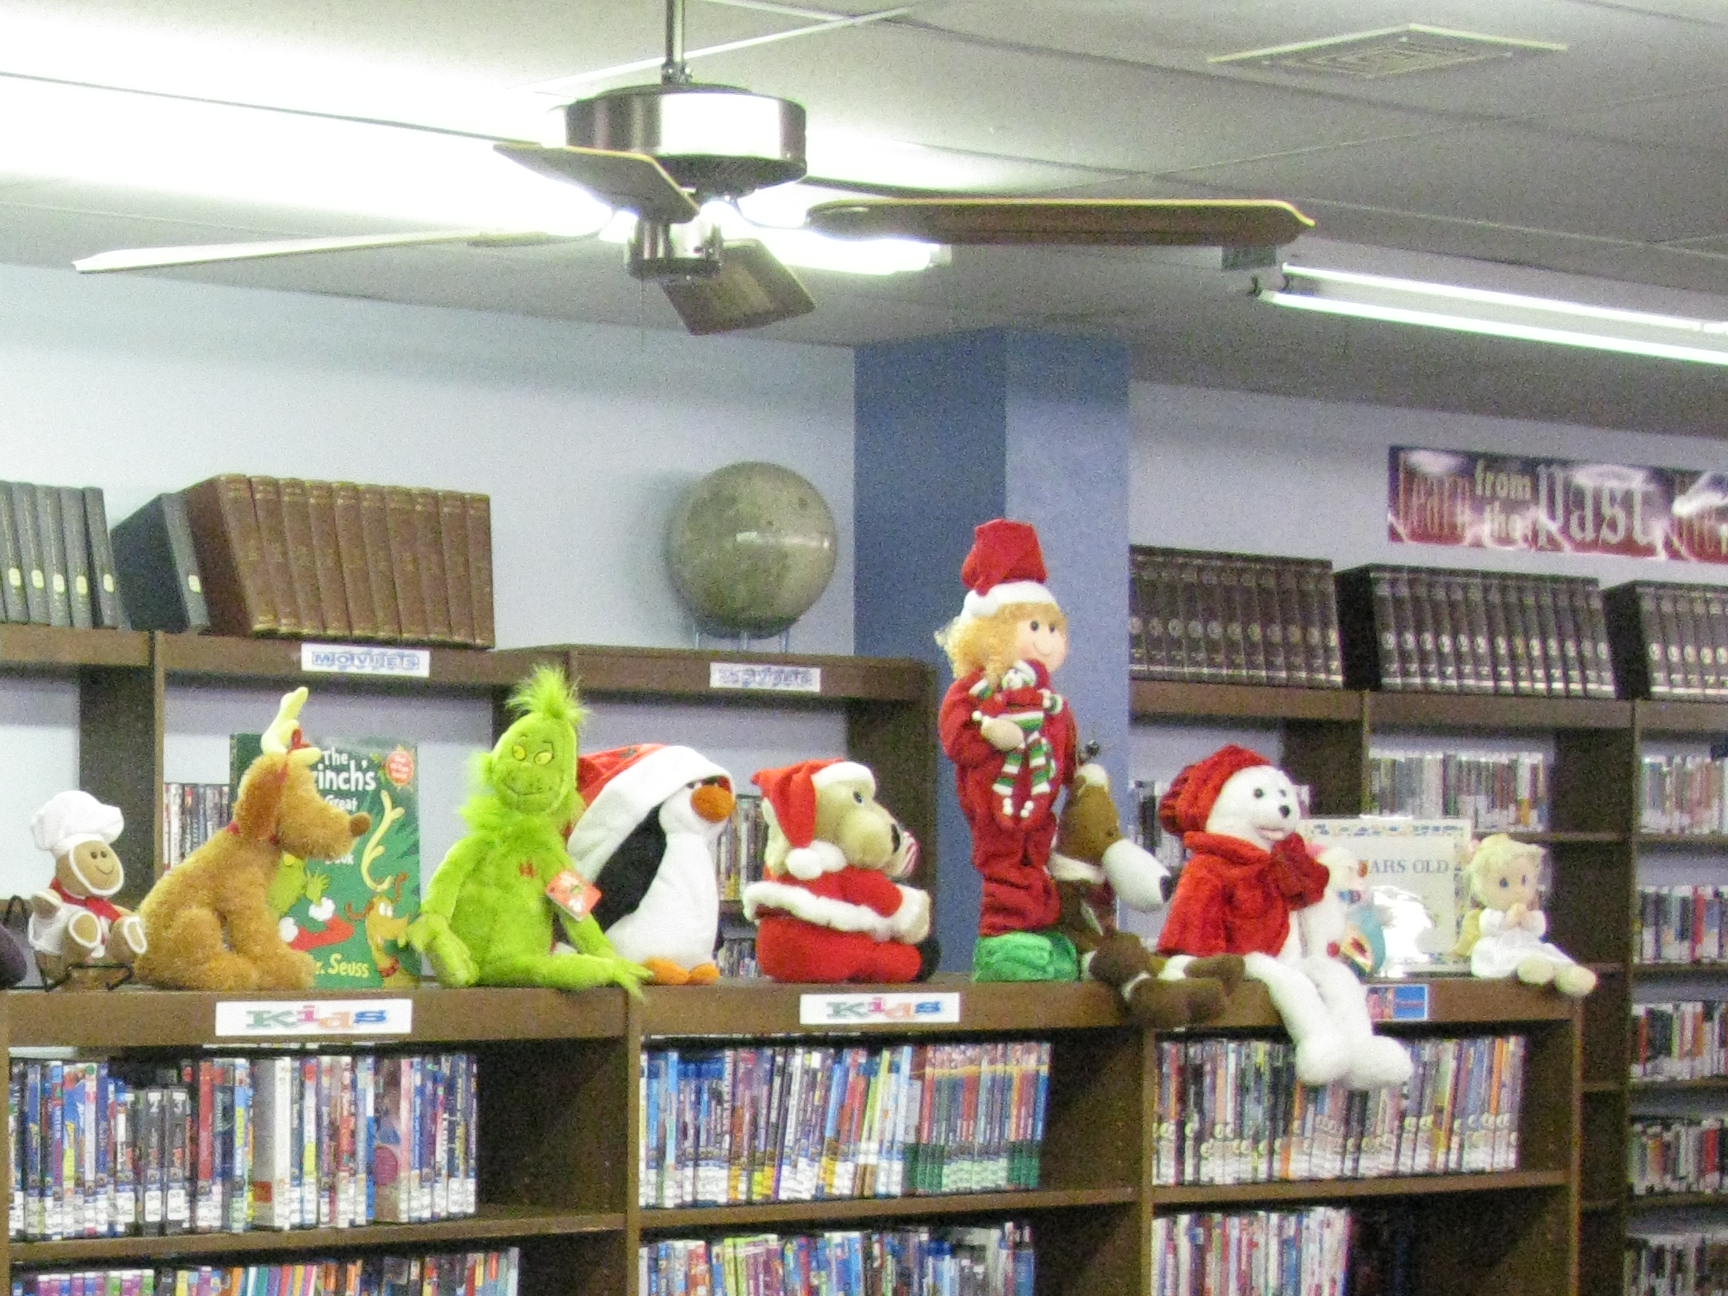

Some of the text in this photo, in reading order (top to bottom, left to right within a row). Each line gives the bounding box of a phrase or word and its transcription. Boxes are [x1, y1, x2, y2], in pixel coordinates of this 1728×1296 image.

[311, 760, 377, 791] rinch's
[1369, 859, 1450, 874] ARS OLD
[245, 1004, 388, 1029] Kids
[825, 997, 941, 1020] Kids
